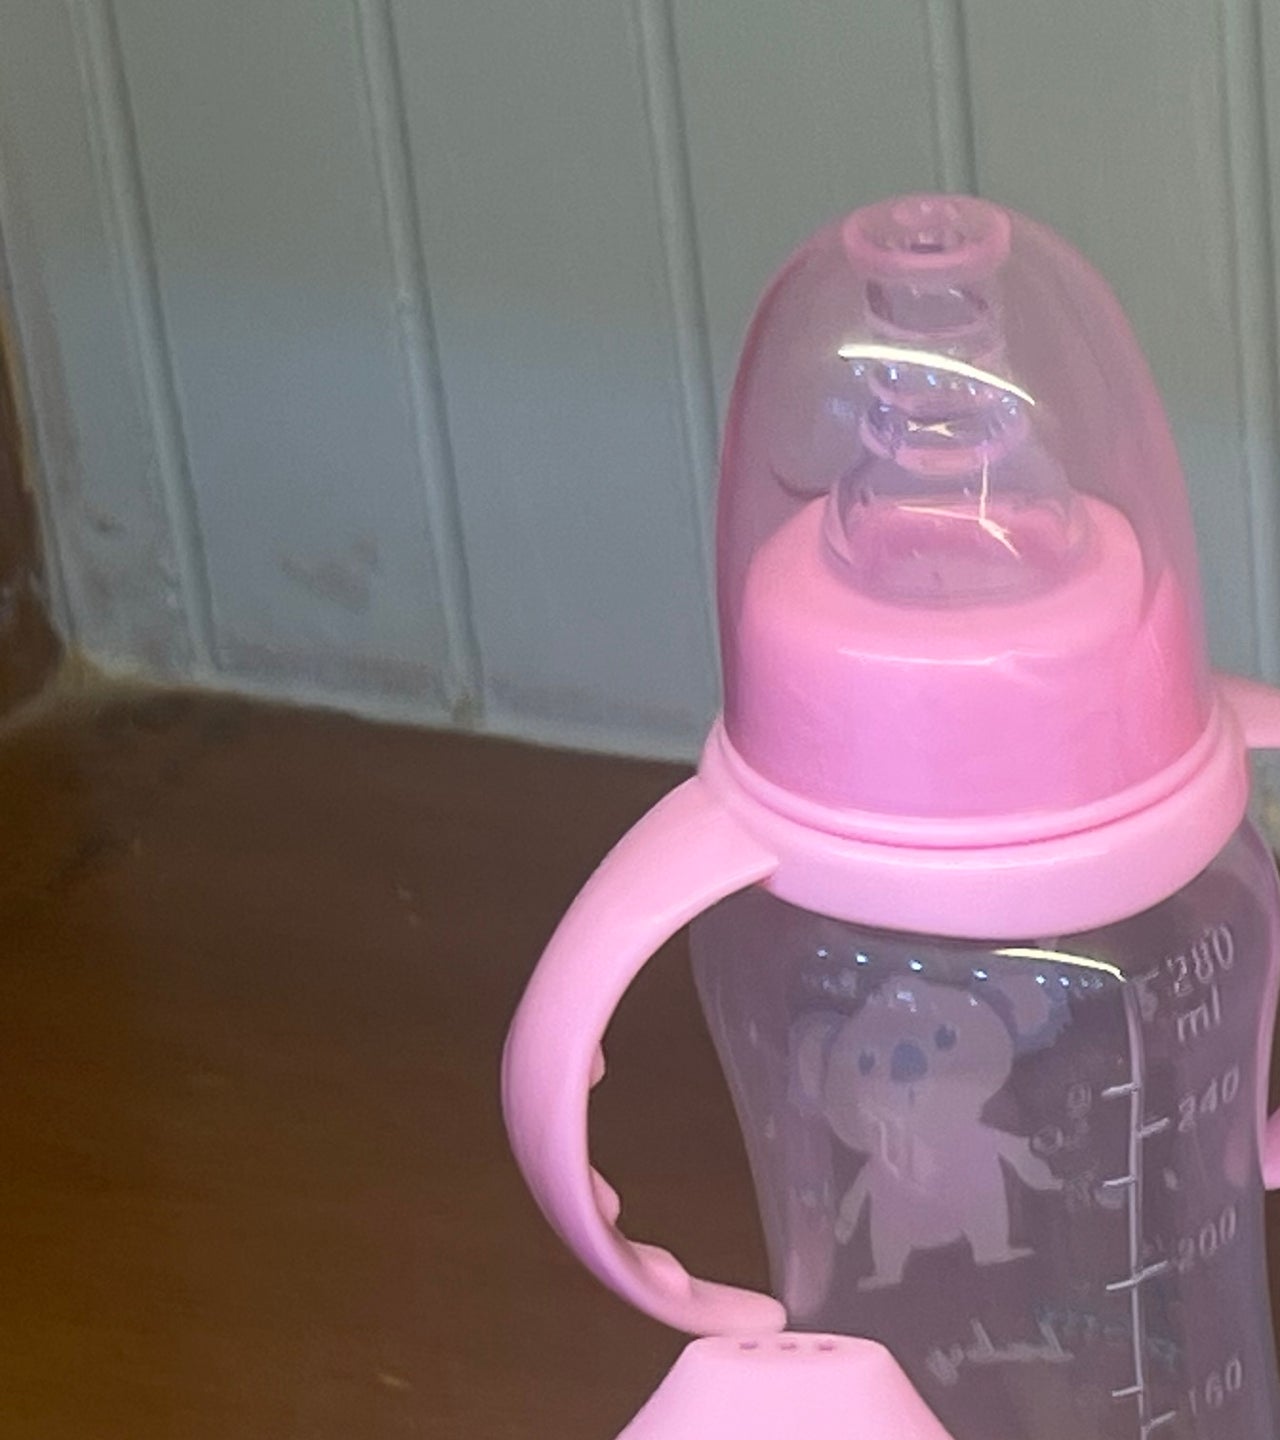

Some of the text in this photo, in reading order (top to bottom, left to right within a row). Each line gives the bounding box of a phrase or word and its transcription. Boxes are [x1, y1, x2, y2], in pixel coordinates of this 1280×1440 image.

[1175, 984, 1224, 1045] ml
[1176, 1063, 1240, 1134] 240
[1177, 1204, 1238, 1274] 200
[1187, 1357, 1243, 1417] 160
